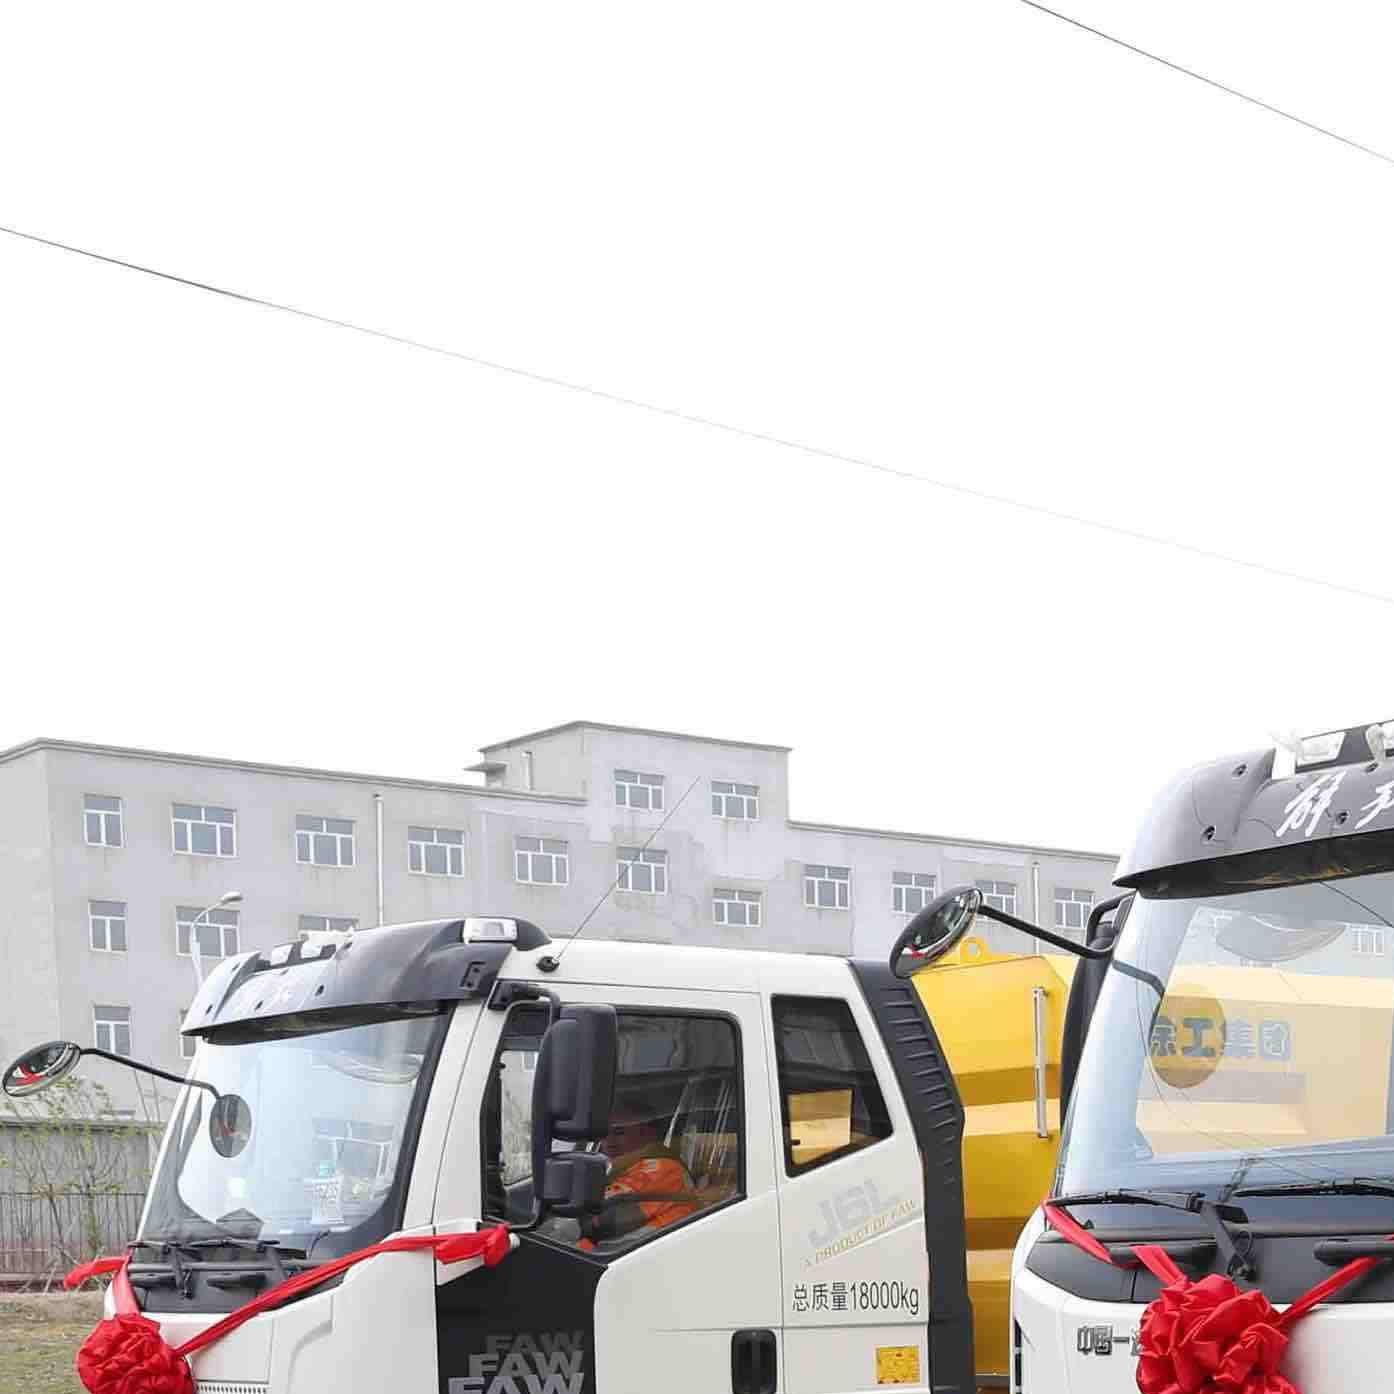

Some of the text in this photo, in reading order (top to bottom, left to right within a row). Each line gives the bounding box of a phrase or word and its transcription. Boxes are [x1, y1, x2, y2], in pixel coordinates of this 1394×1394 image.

[792, 1281, 919, 1315] 总质量18000kg
[469, 1350, 585, 1380] FAW
